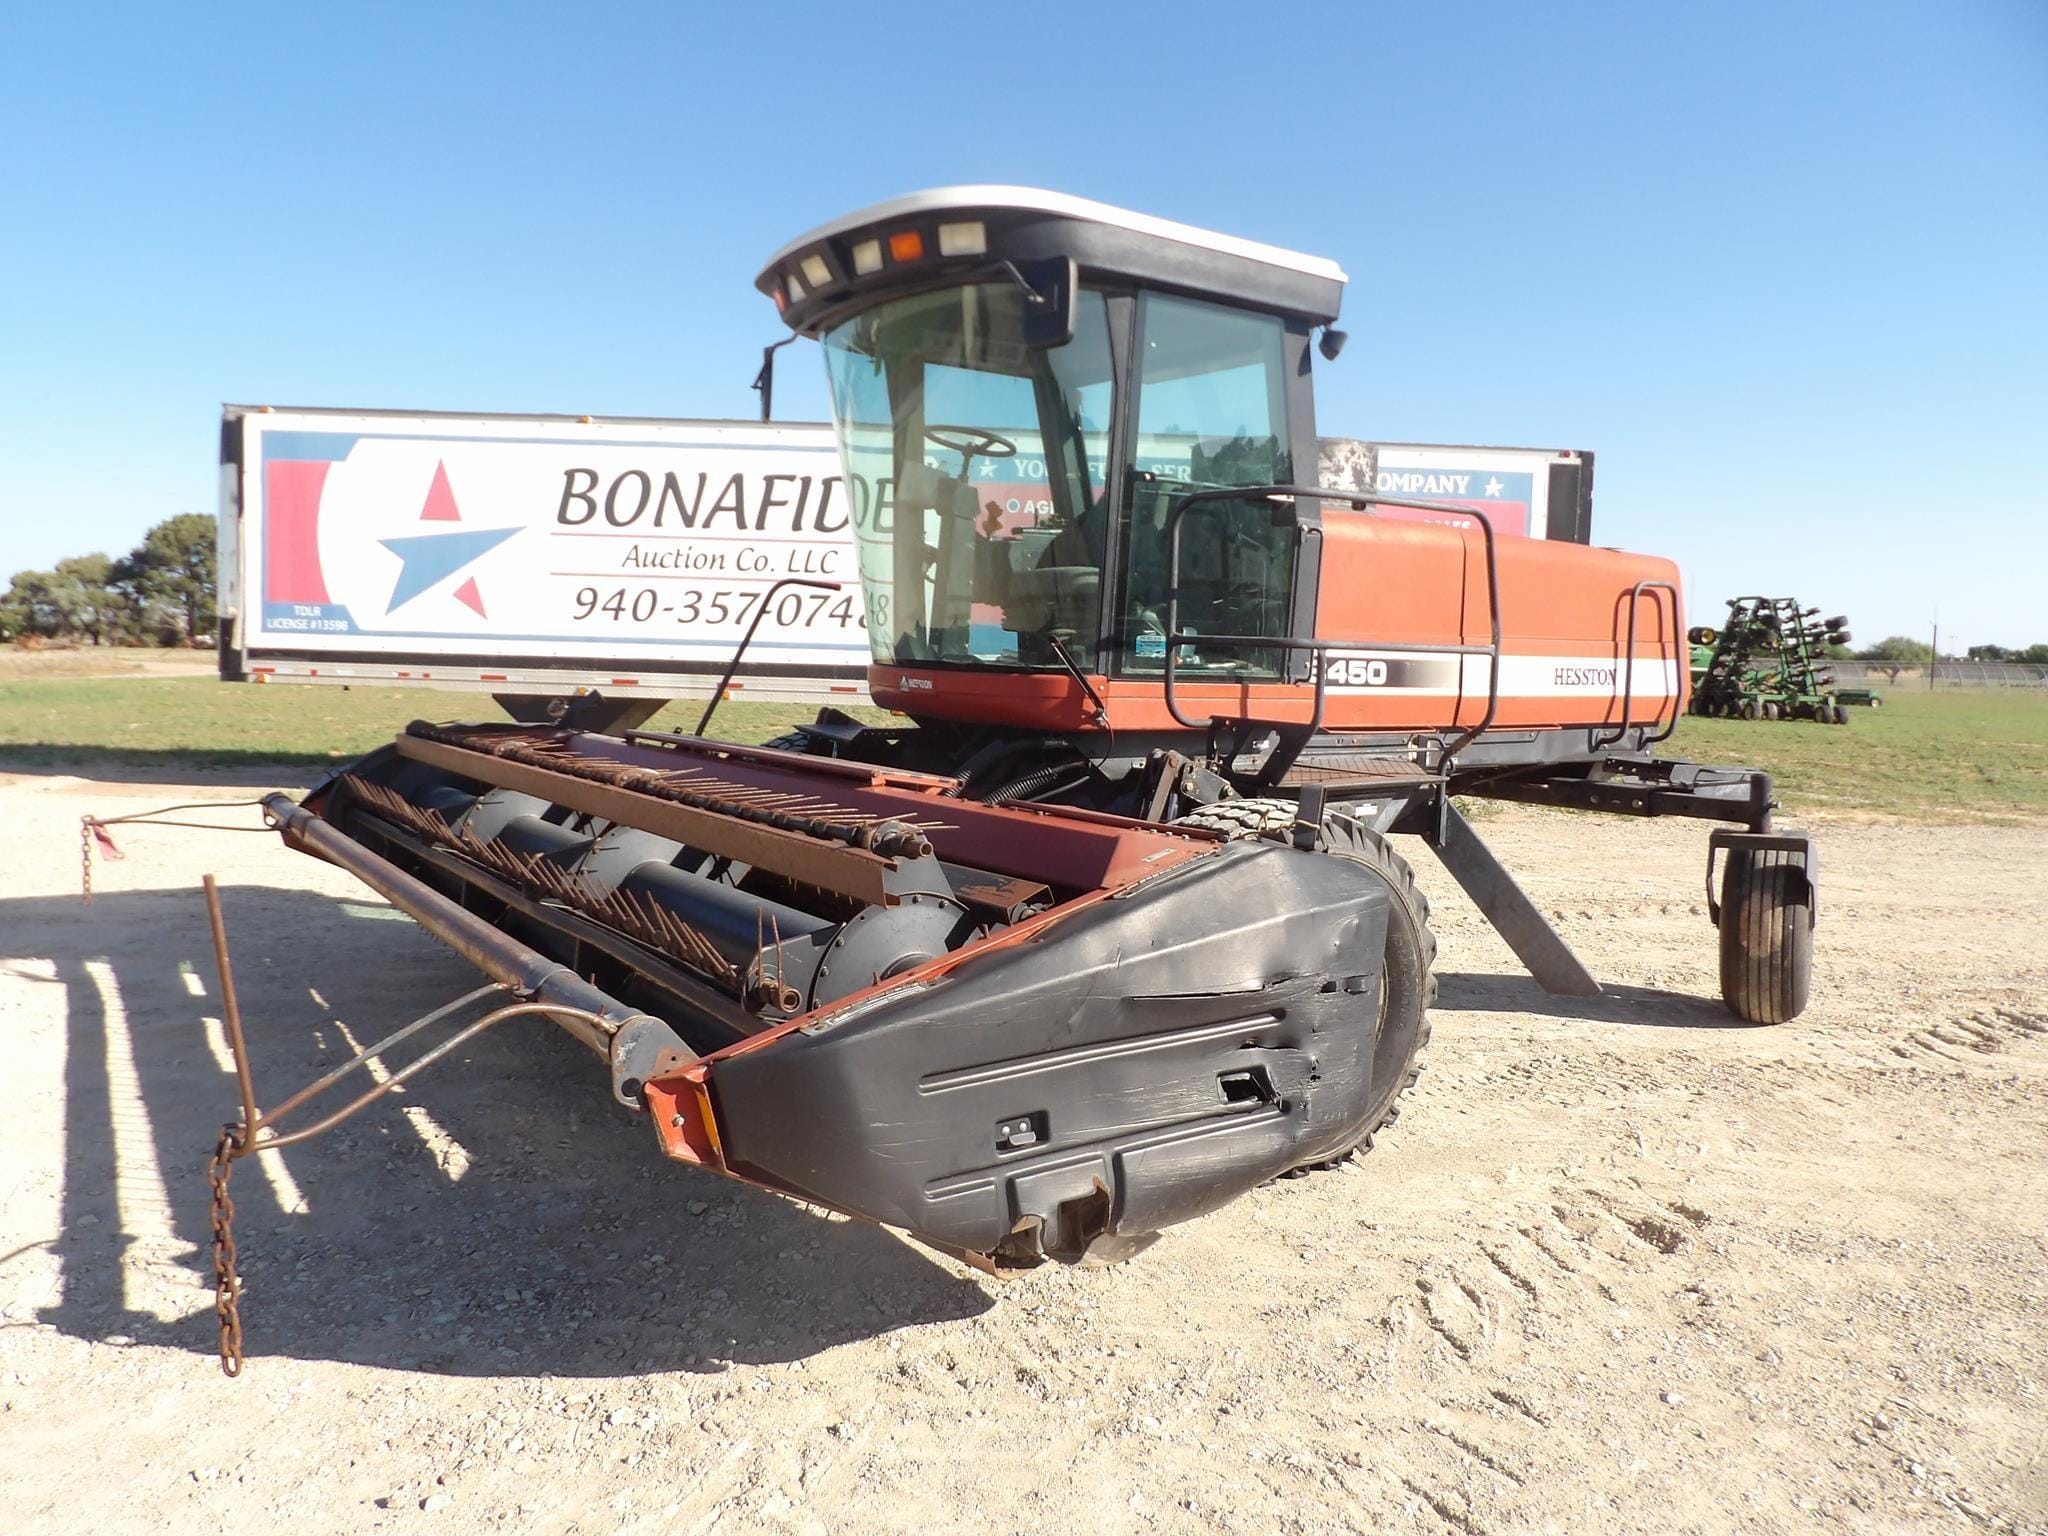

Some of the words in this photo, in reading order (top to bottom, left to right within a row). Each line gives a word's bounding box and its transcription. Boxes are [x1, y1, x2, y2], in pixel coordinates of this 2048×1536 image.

[557, 468, 893, 533] BONAFIDE
[622, 544, 725, 571] Auction
[736, 547, 775, 573] Co.
[788, 550, 838, 574] LLC
[293, 604, 321, 617] TDLR
[573, 587, 888, 629] 940-357-0748
[267, 618, 309, 630] LICENSE
[1554, 668, 1617, 687] HESSTON
